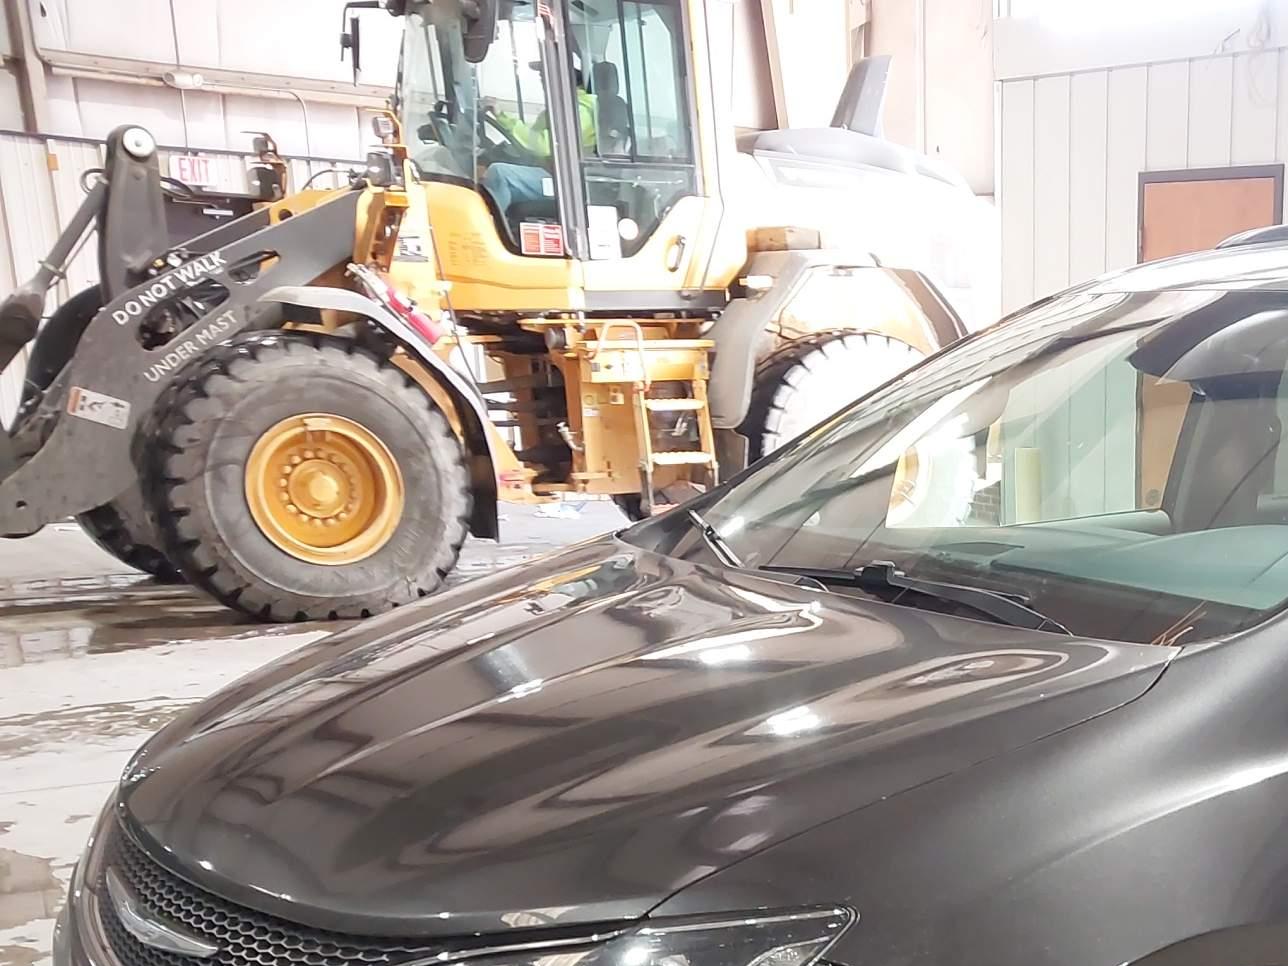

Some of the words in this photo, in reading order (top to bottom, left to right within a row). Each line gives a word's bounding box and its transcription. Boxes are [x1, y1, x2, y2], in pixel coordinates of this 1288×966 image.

[178, 157, 209, 183] EXIT
[112, 301, 142, 325] DO
[138, 275, 177, 307] NOT
[173, 250, 227, 284] WALK
[143, 340, 199, 382] UNDER
[195, 310, 238, 345] MAST
